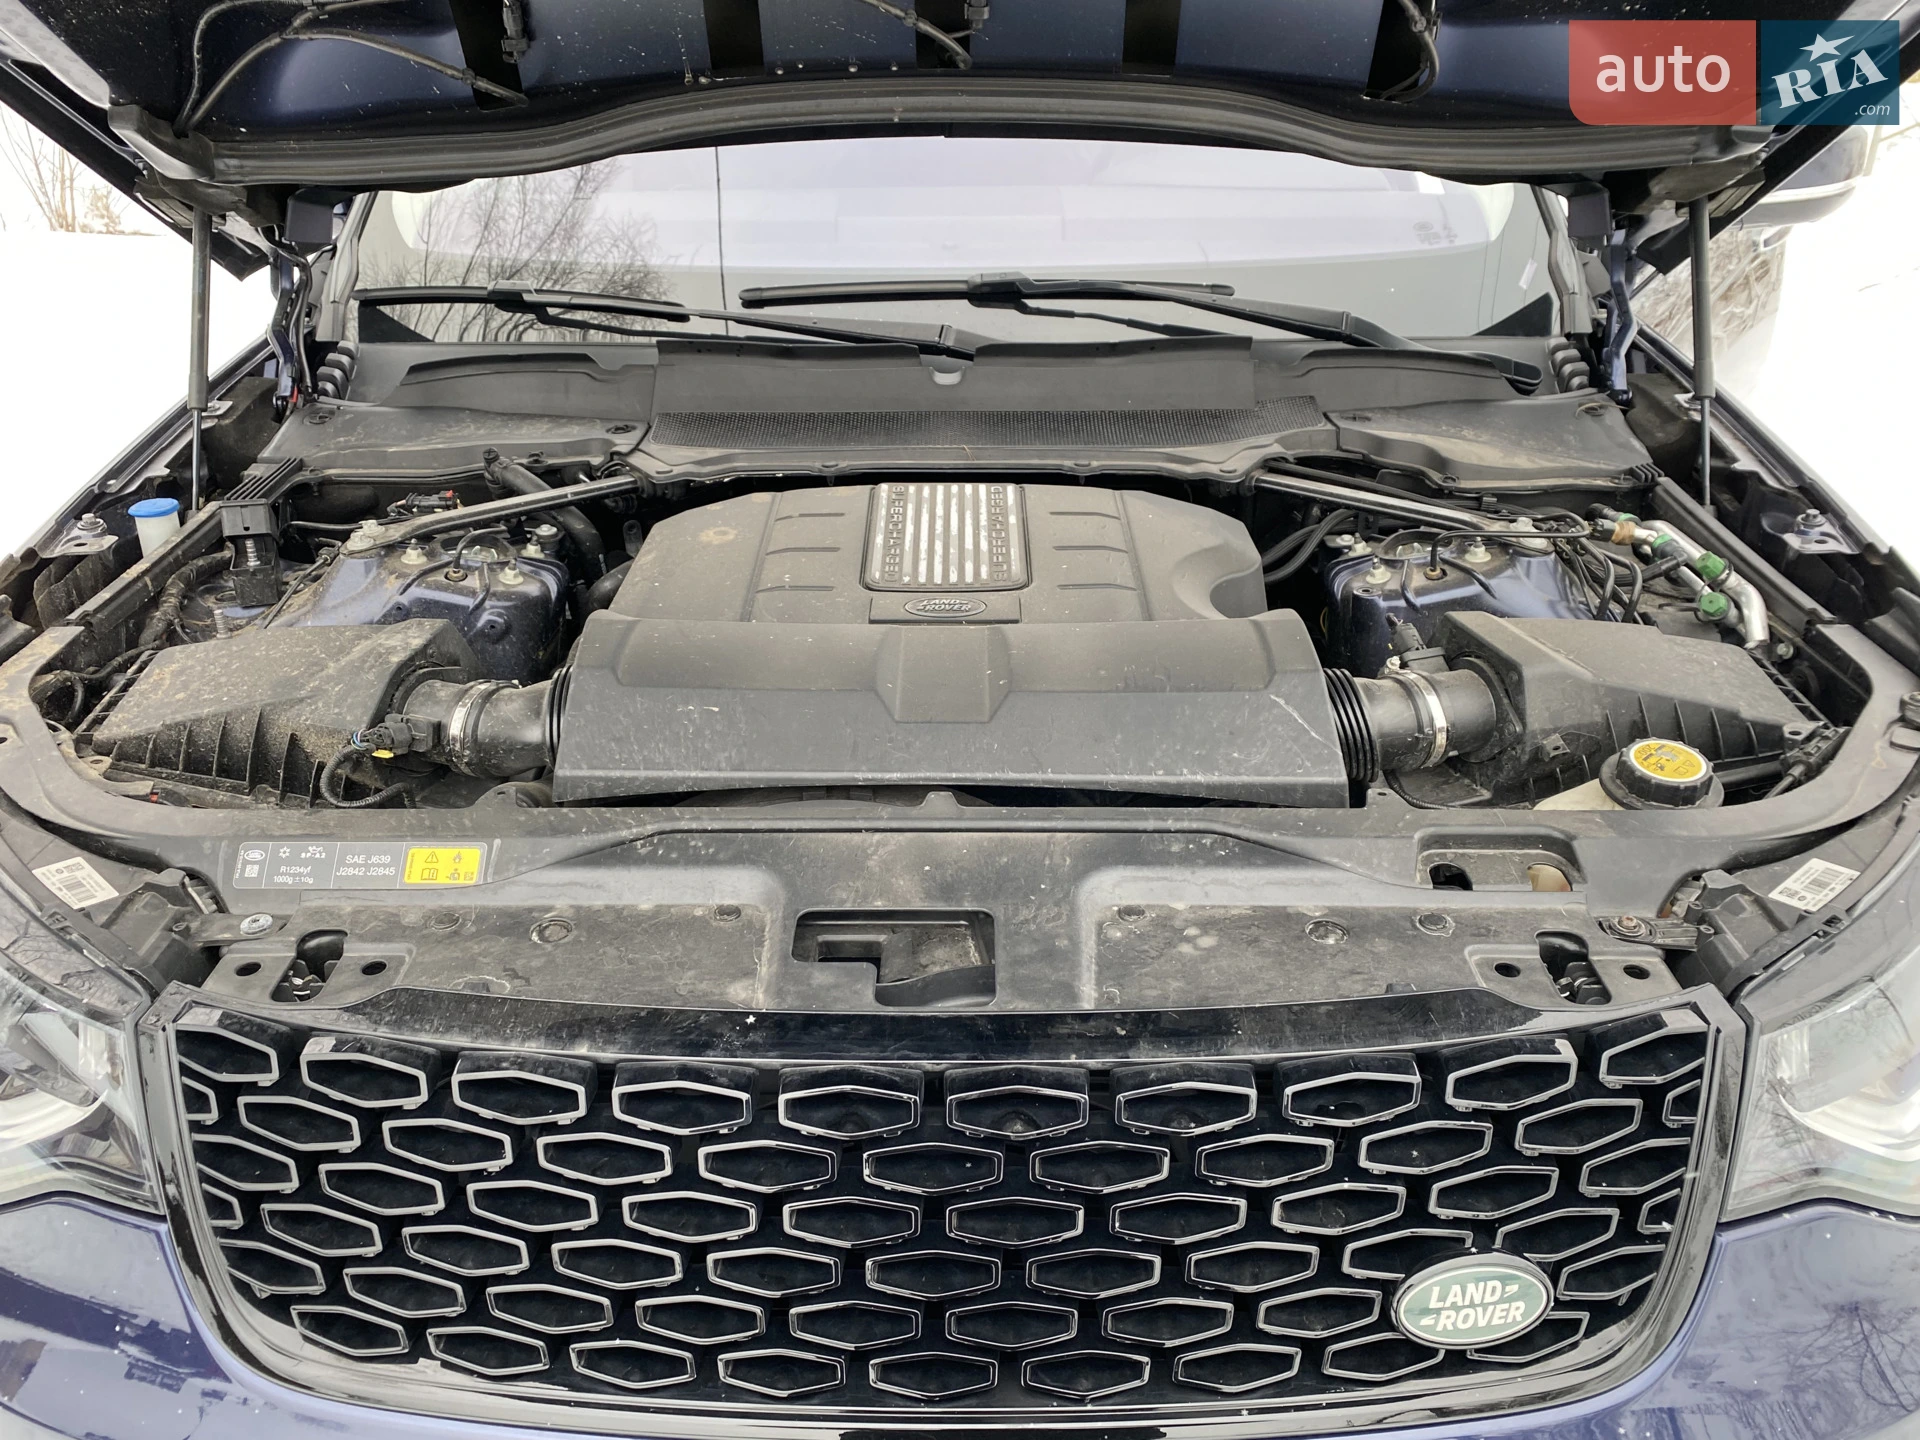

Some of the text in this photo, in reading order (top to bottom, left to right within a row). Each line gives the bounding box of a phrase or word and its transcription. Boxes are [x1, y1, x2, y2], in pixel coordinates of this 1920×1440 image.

[884, 485, 905, 583] SUPERCHARGED
[990, 485, 1008, 583] SUPERCHARGED
[925, 604, 972, 612] ROVER
[345, 855, 391, 864] SAE J639
[280, 866, 312, 875] R1234yf
[336, 867, 396, 876] J2842 J2845
[273, 876, 293, 885] 1000g
[1429, 1280, 1502, 1309] LAND
[1435, 1301, 1526, 1331] ROVER
